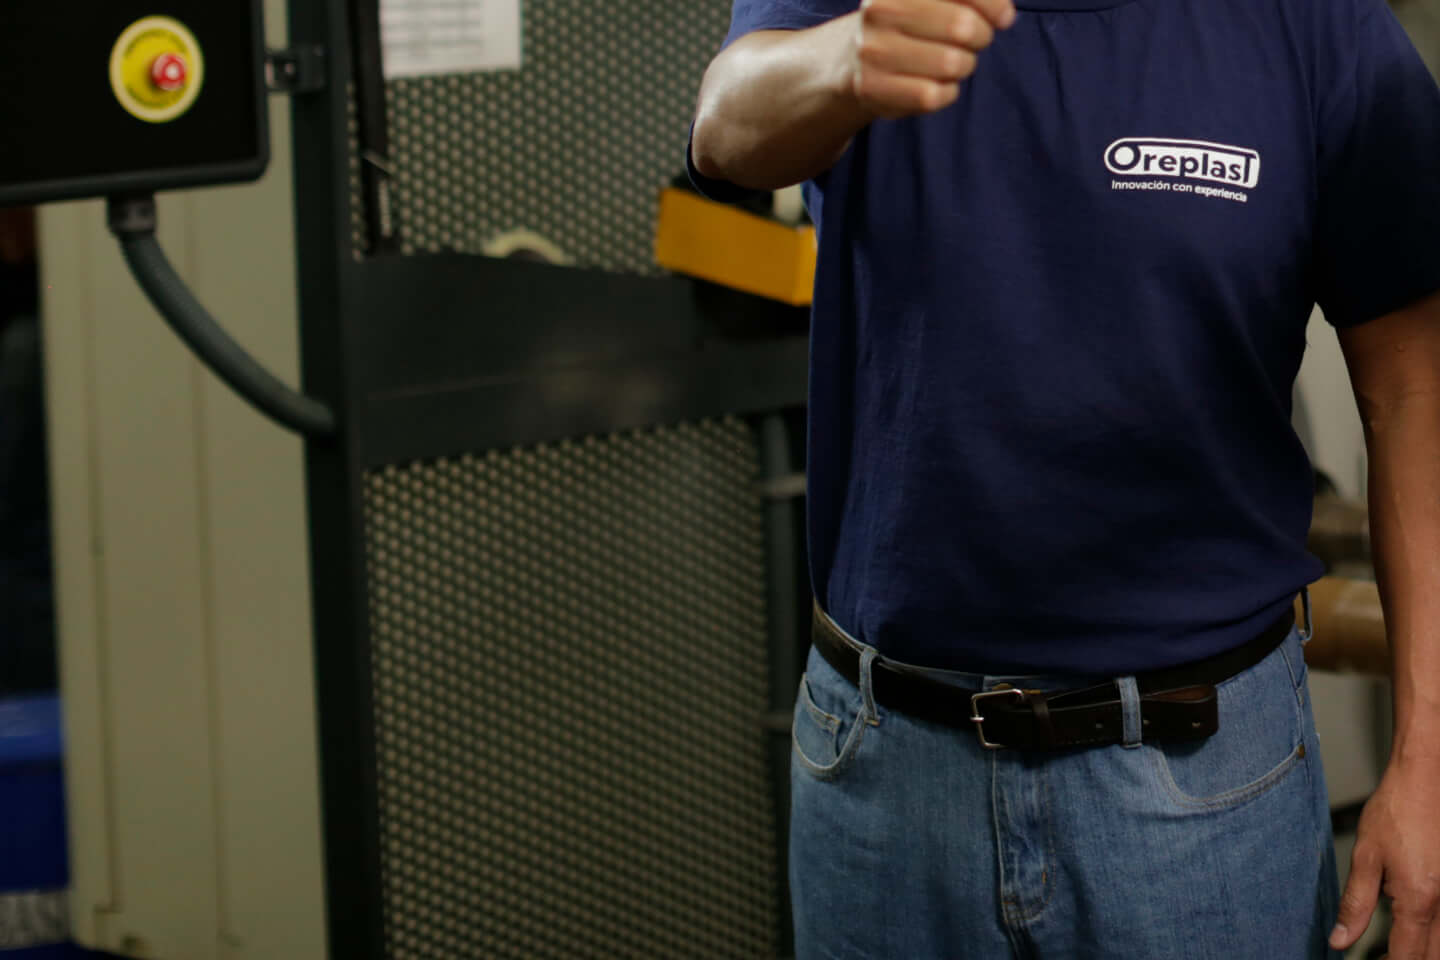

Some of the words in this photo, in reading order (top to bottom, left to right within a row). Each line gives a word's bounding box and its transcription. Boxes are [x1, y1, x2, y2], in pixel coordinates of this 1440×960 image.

[1111, 179, 1171, 191] Innovación
[1172, 182, 1193, 193] con
[1194, 185, 1247, 202] experiencia
